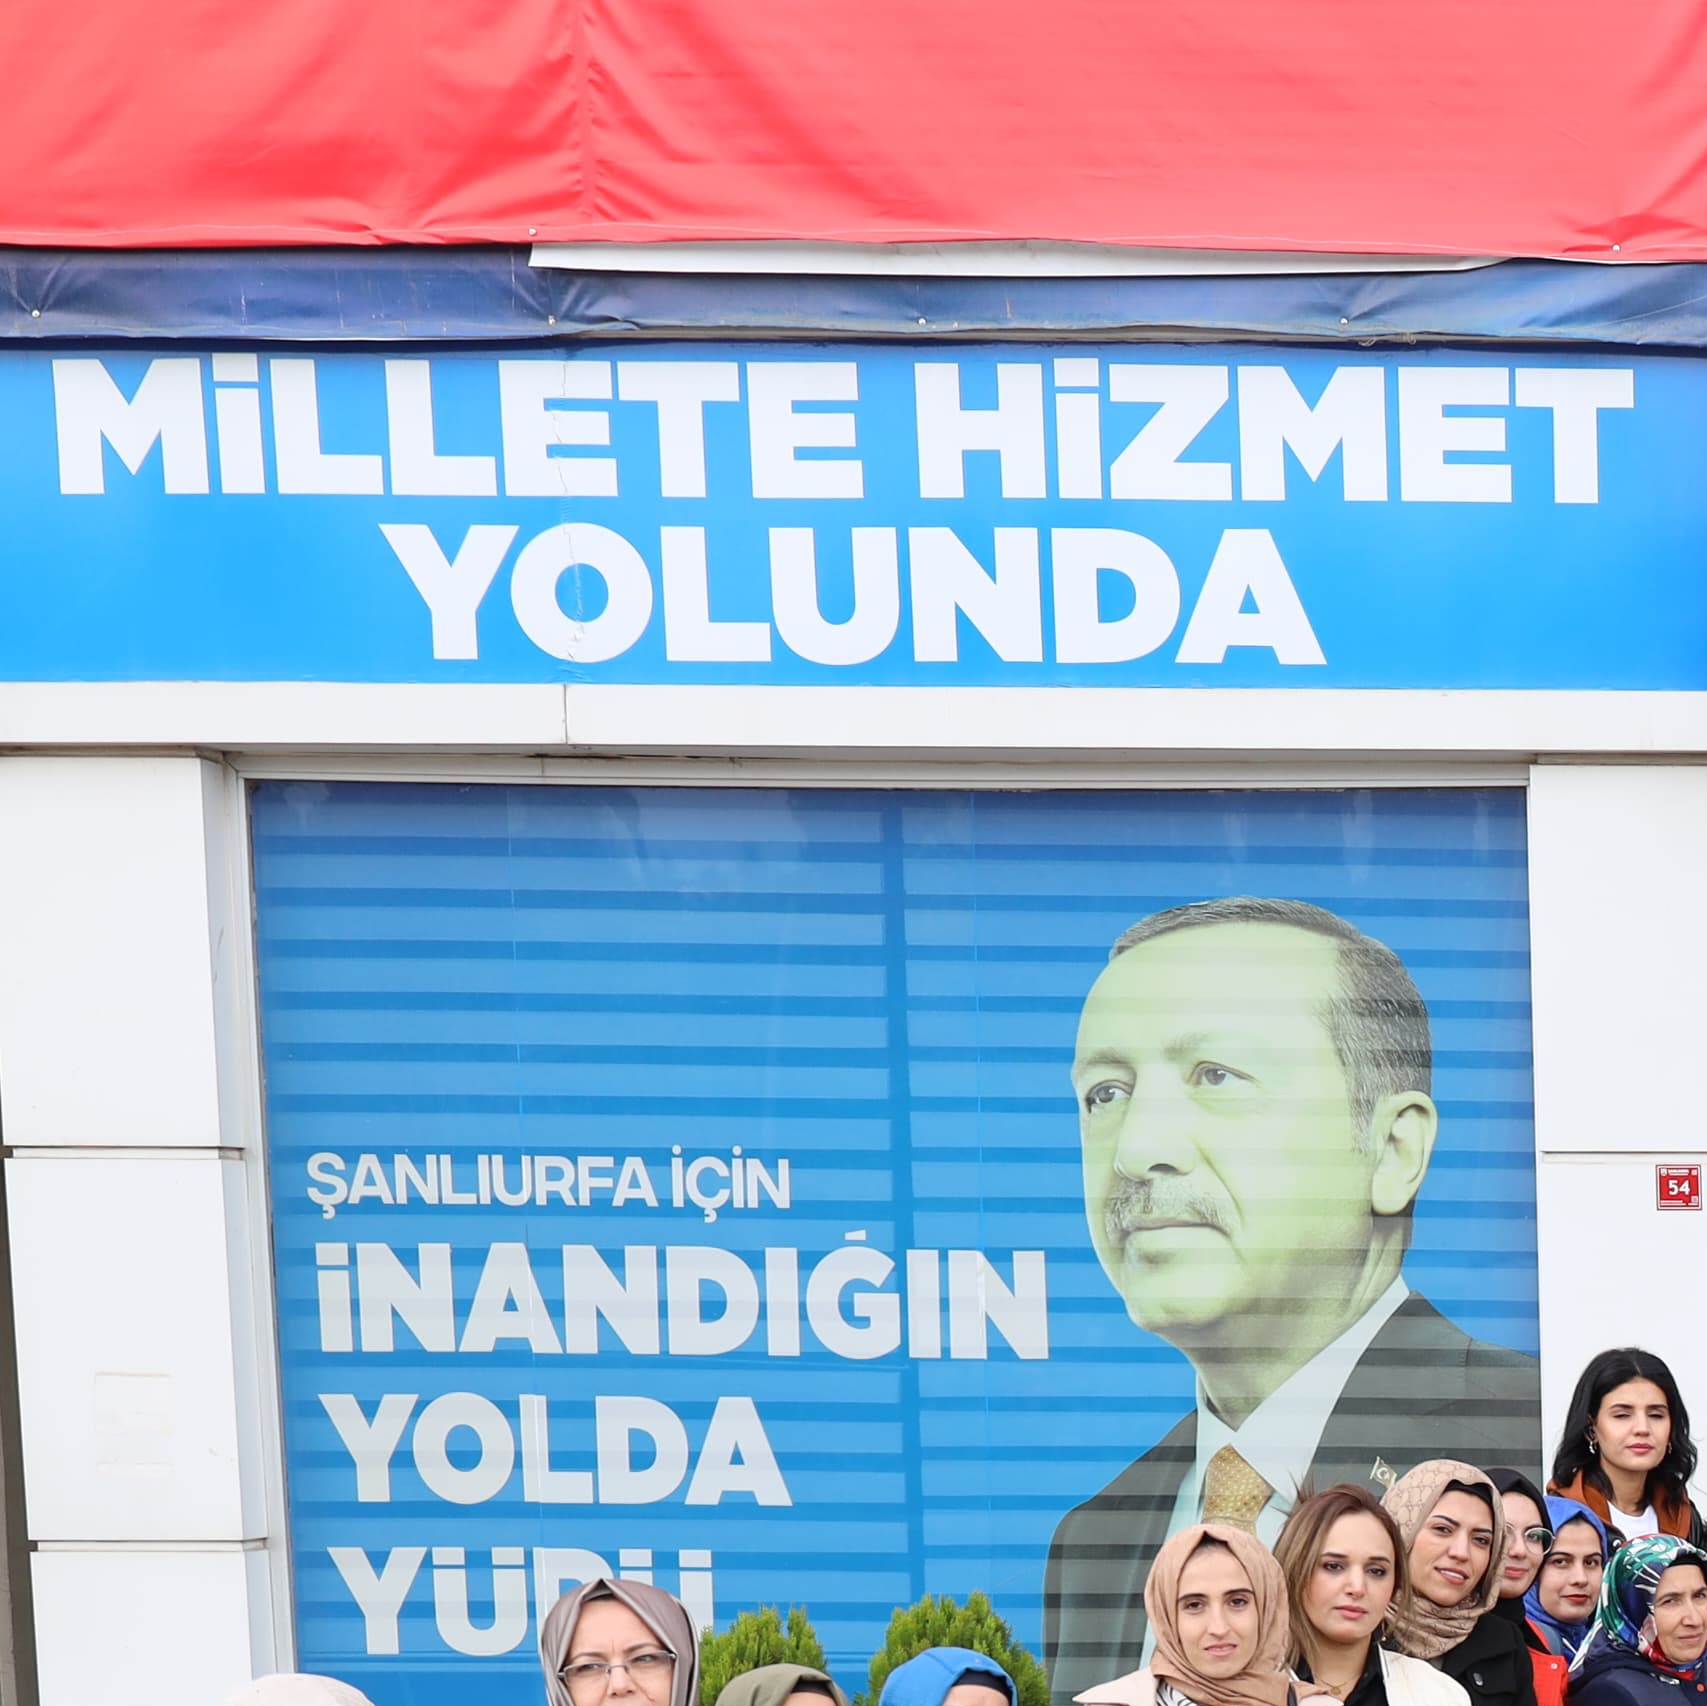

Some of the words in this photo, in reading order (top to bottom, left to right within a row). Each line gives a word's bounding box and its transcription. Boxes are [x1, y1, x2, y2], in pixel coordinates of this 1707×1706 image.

[378, 522, 1327, 665] YOLUNDA
[307, 1152, 657, 1220] ŞANLIURFA
[673, 1145, 790, 1223] İÇİN
[1669, 1180, 1690, 1195] 54
[316, 1230, 1048, 1360] İNANDIĞIN
[319, 1391, 792, 1506] YOLDA
